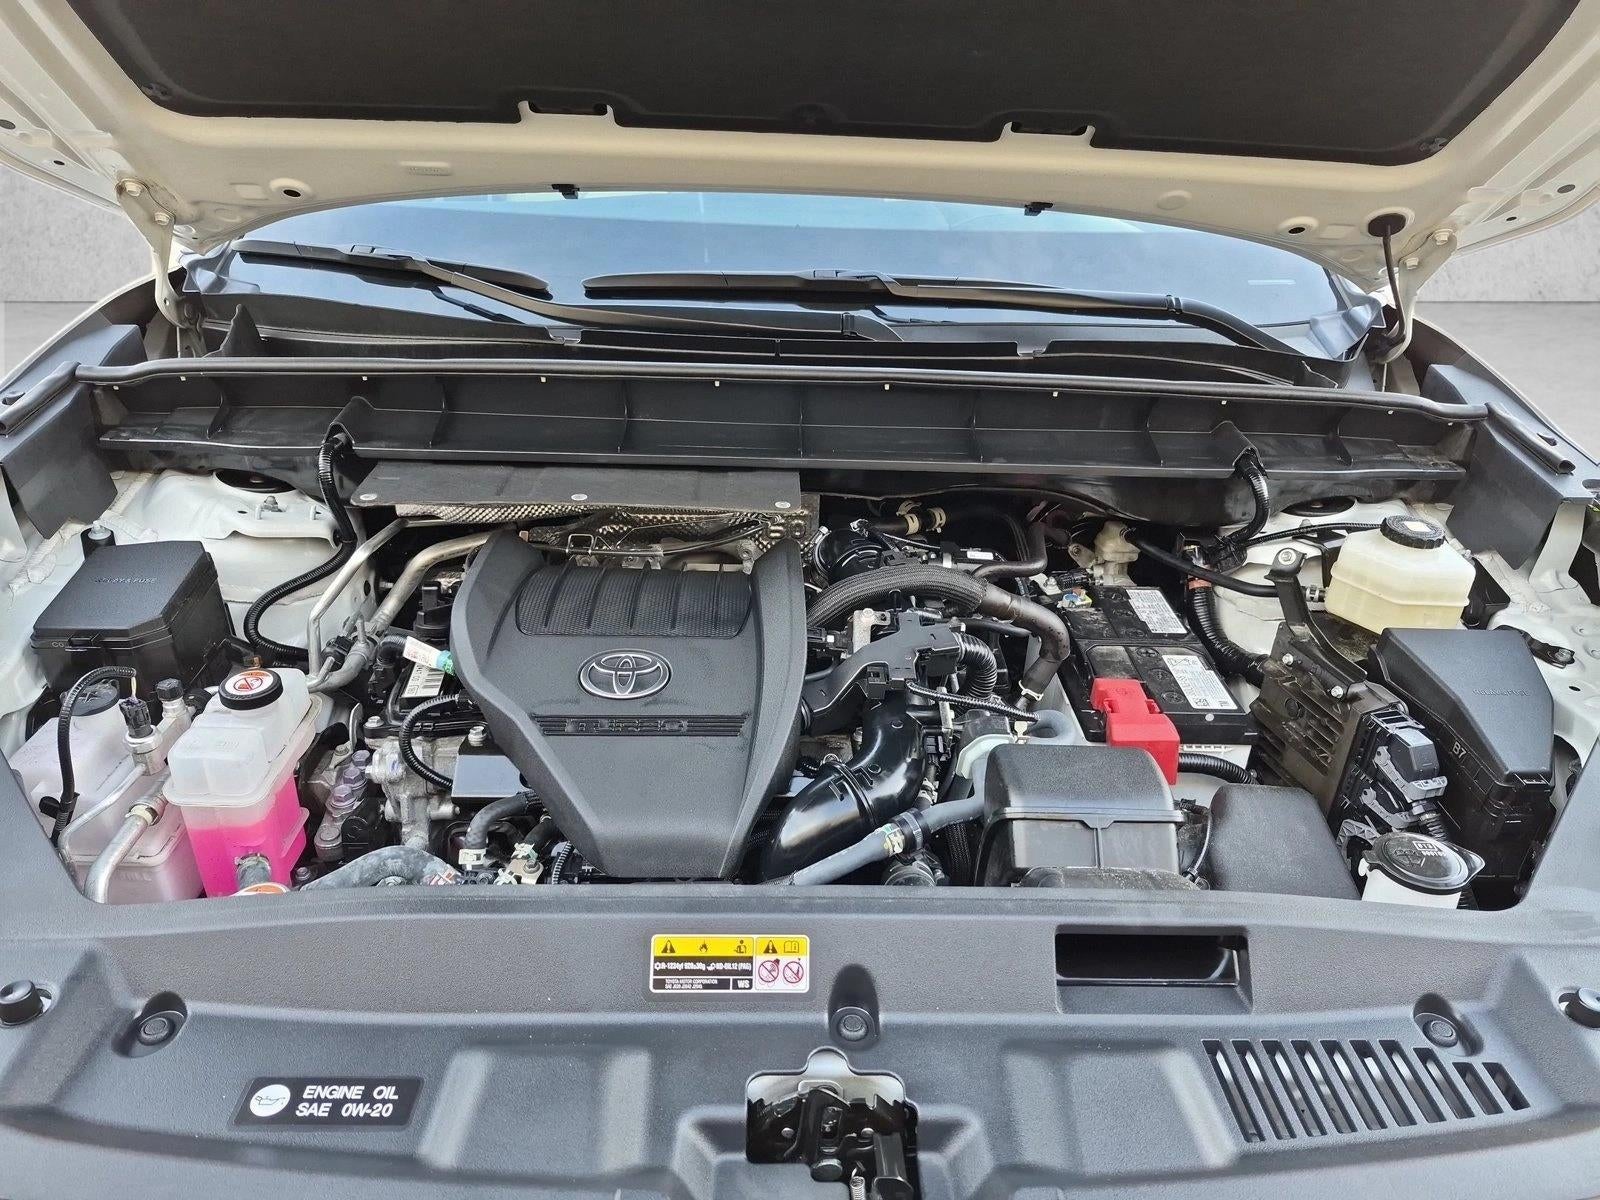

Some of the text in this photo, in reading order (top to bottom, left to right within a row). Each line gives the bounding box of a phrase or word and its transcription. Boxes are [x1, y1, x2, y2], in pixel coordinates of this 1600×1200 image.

[1452, 741, 1467, 759] B7
[737, 979, 750, 989] WS
[302, 1085, 399, 1100] ENGINE OIL
[295, 1102, 394, 1118] SAE 0W-20
